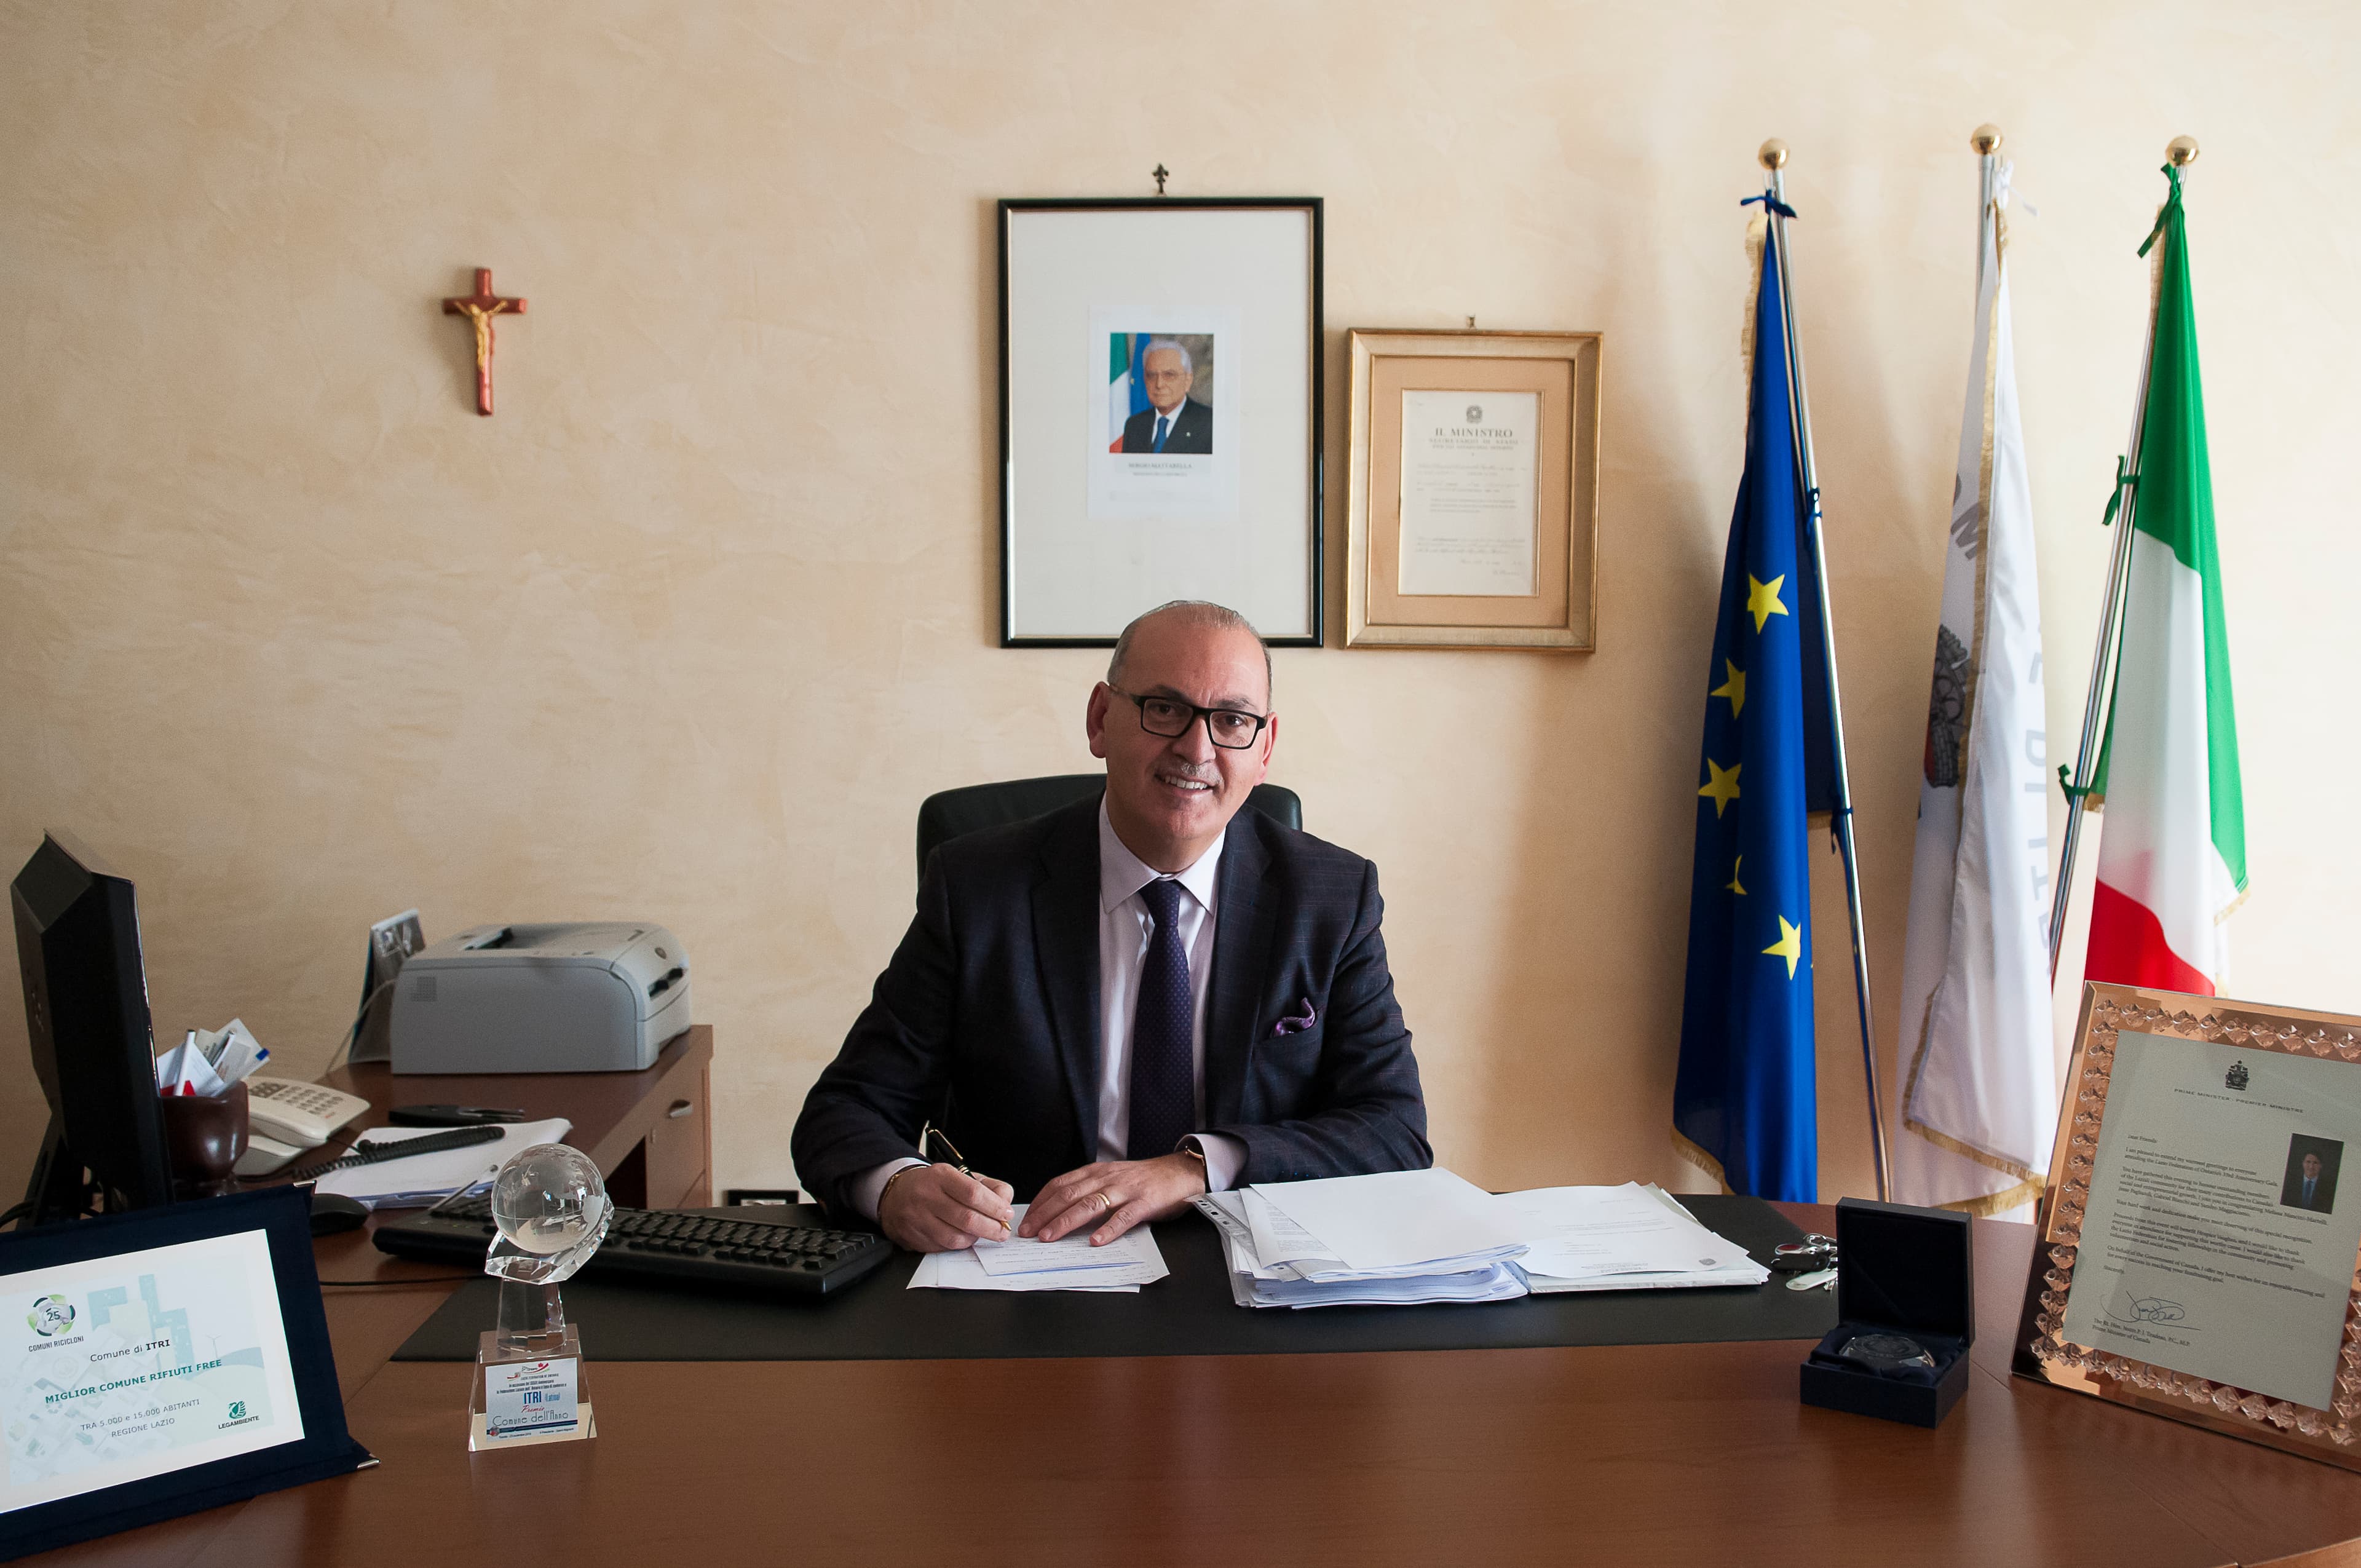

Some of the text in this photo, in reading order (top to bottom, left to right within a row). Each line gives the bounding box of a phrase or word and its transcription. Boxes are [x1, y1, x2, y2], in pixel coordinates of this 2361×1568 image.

[1451, 428, 1513, 437] MINISTRO
[47, 1310, 60, 1321] 25
[28, 1336, 84, 1352] COMUNI RICICLONI
[90, 1348, 130, 1362] Comune
[145, 1339, 170, 1351] ITRI
[45, 1359, 222, 1403] MIGLIOR COMUNE RIFIUTI FREE
[524, 1391, 542, 1404] ITRI
[80, 1422, 97, 1431] TRA
[100, 1416, 123, 1427] 5.000
[133, 1408, 161, 1419] 15.000
[163, 1399, 200, 1412] ABITANTI
[218, 1416, 259, 1429] LEGAMBIENTE
[492, 1410, 569, 1427] Comune dell'Anno
[111, 1417, 175, 1437] REGIONE LAZIO
